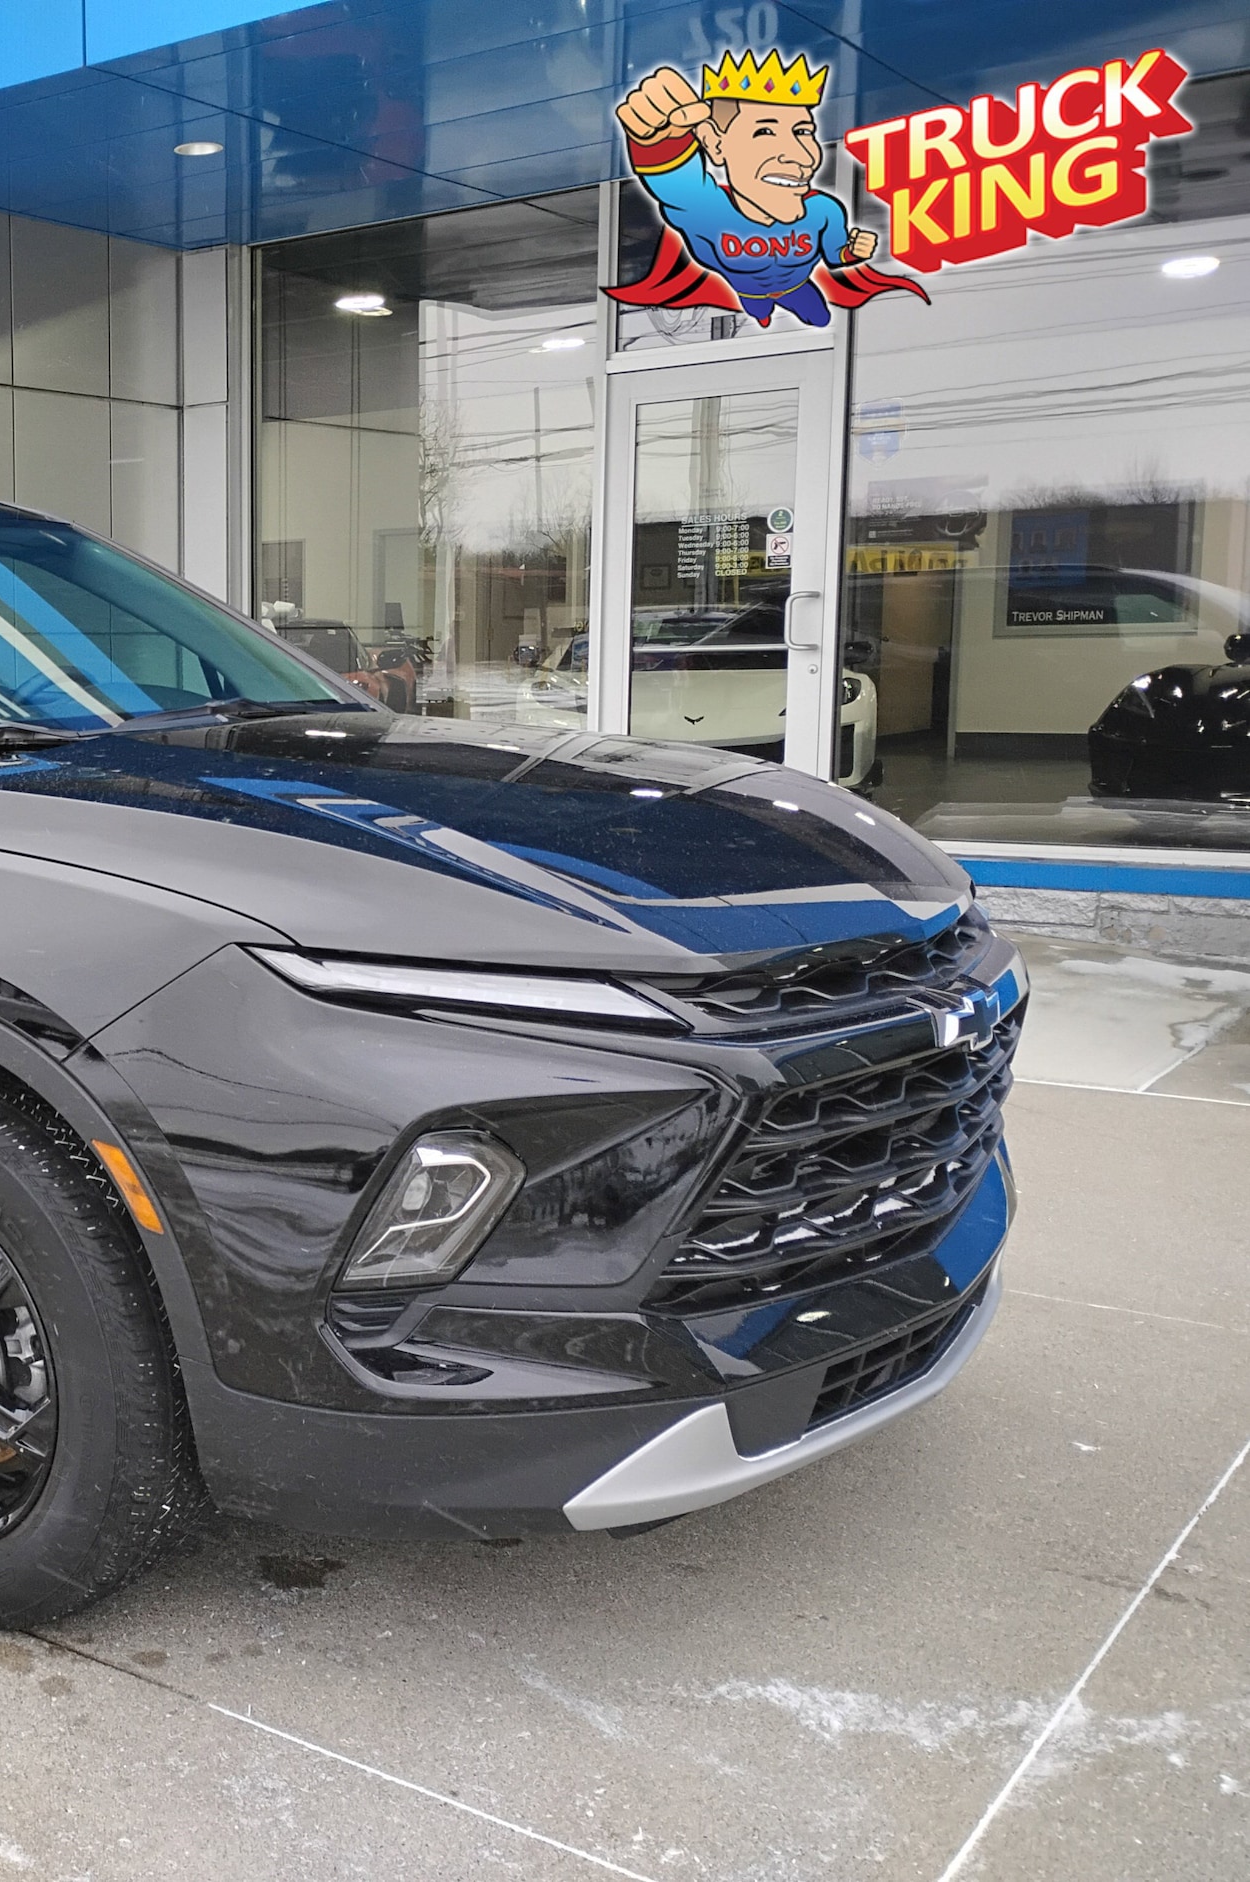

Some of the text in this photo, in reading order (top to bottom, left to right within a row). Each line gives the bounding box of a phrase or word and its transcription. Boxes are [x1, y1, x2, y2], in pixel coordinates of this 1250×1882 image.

[682, 512, 748, 524] SALES HOURS
[1012, 609, 1104, 622] TREVOR SHIPMAN
